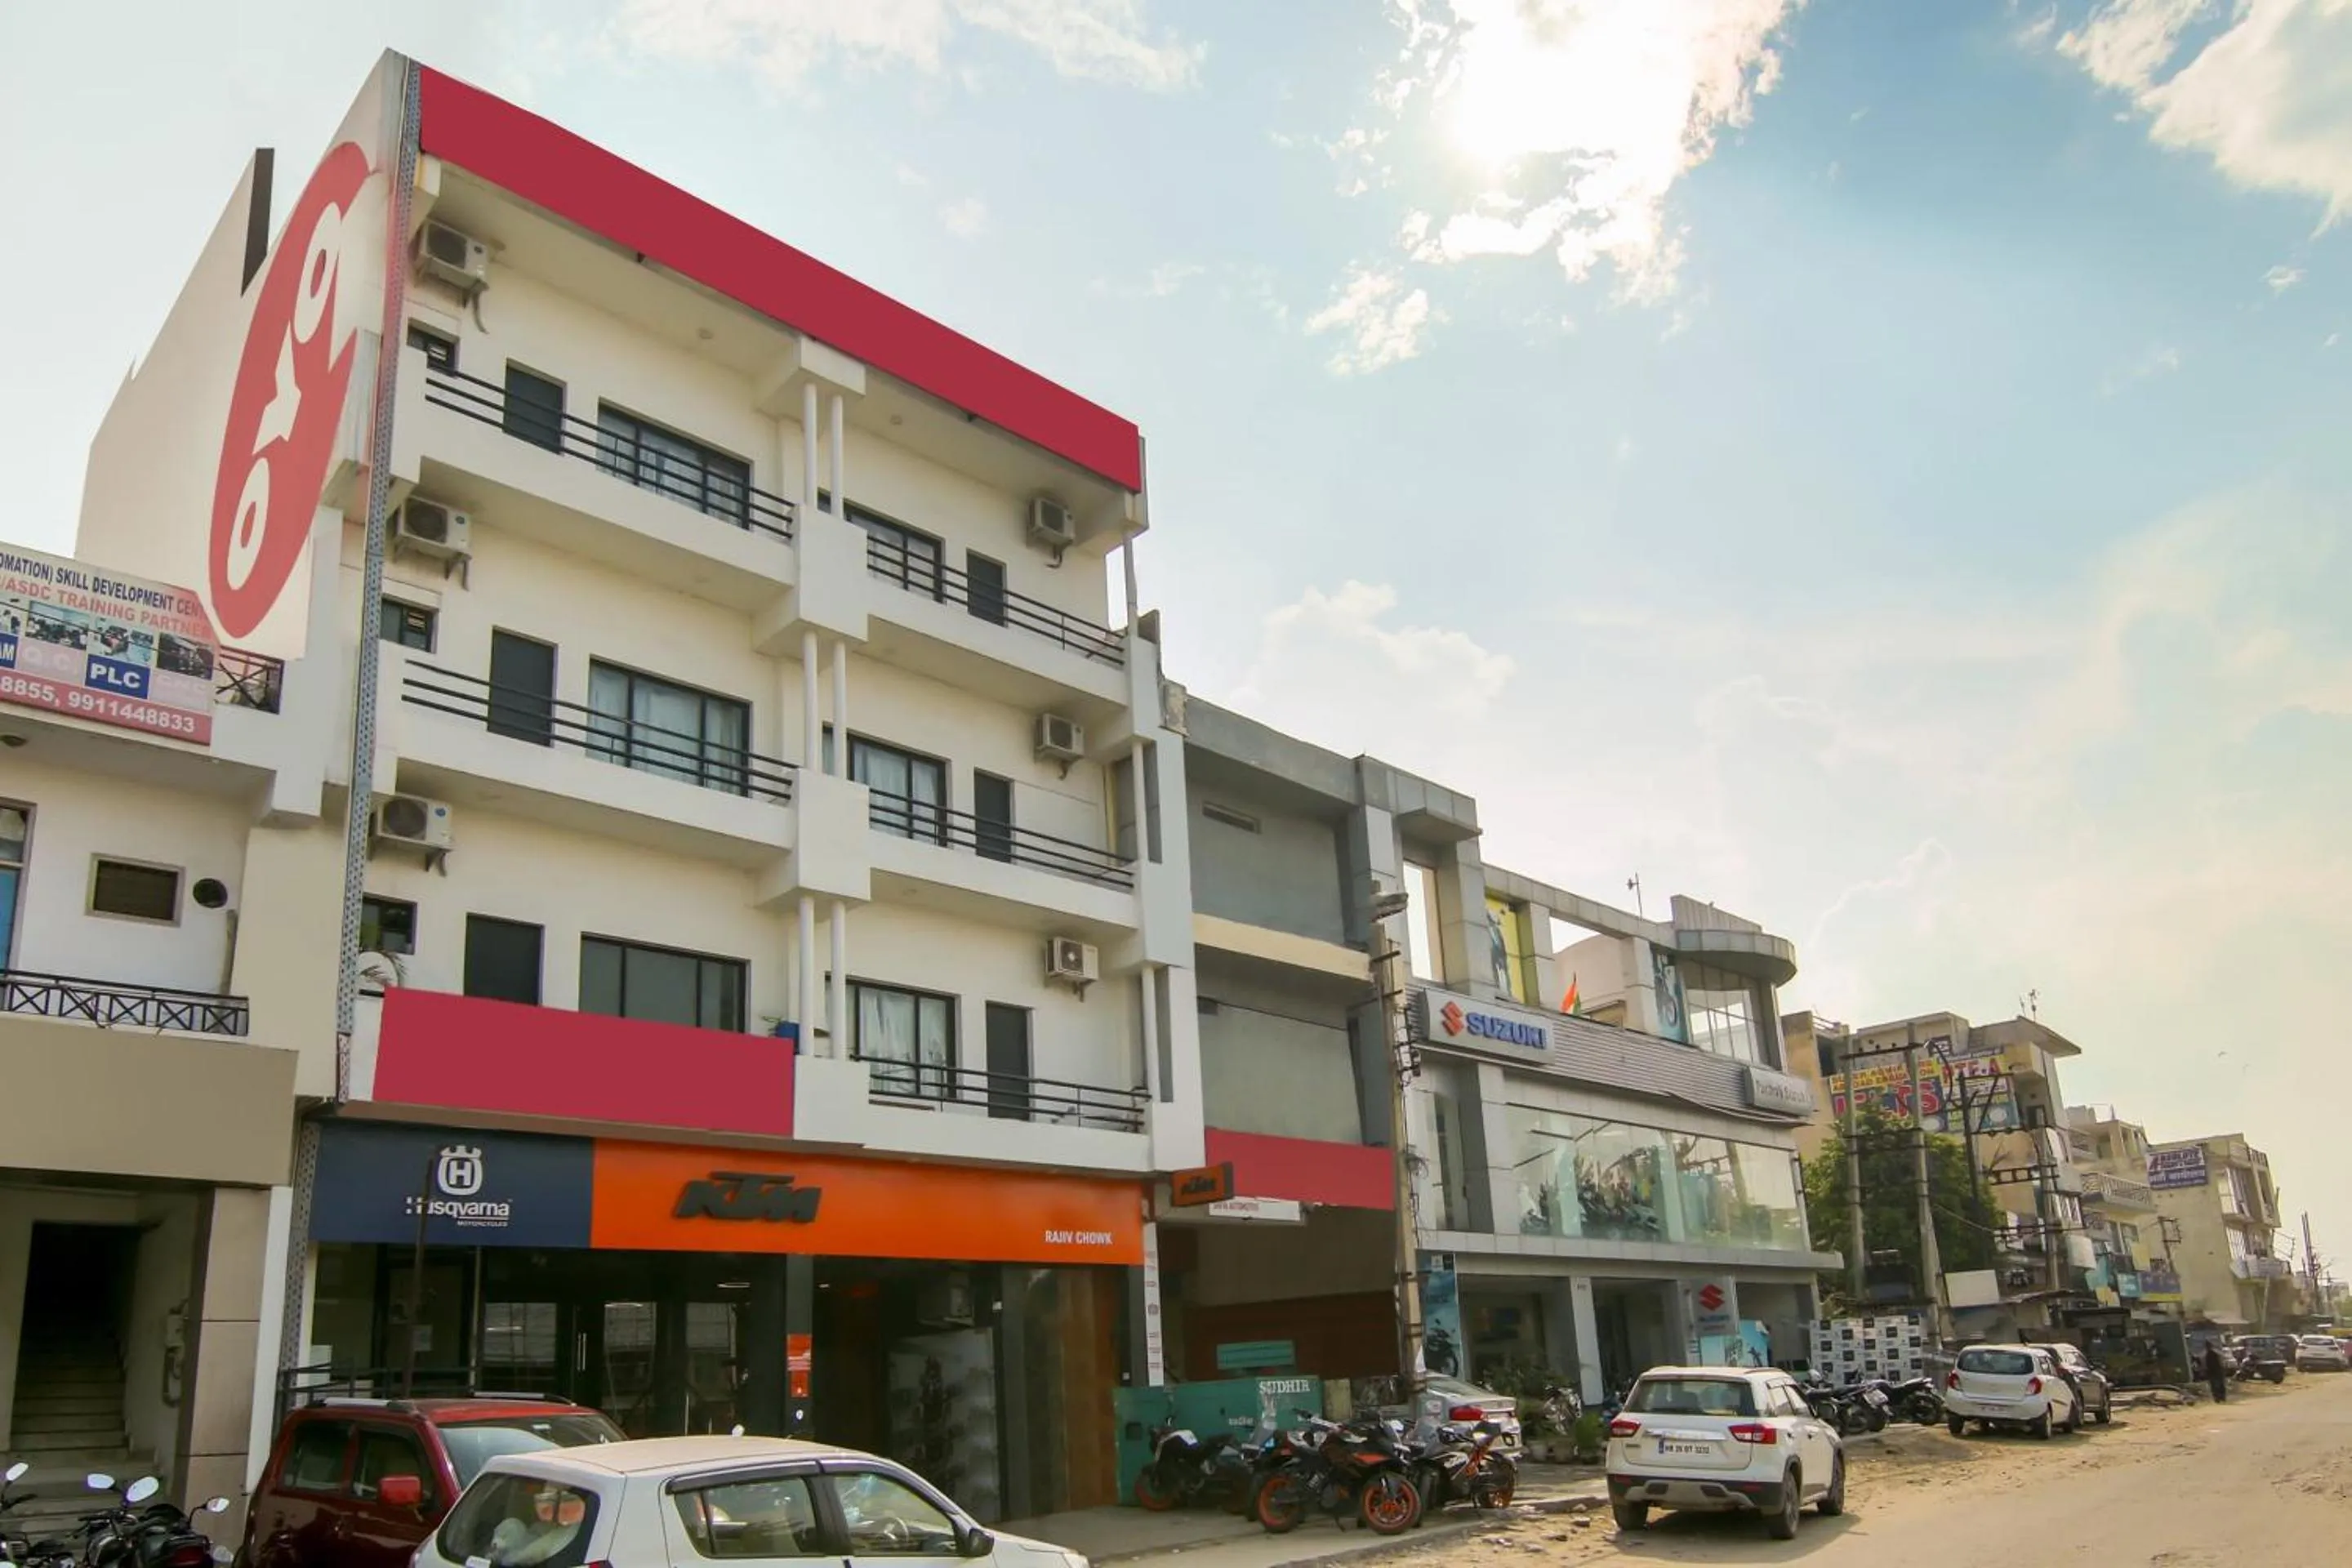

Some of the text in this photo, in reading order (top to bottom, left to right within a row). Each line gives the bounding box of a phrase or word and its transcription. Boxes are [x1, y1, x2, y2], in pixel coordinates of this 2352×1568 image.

[226, 201, 341, 591] OYO
[56, 567, 88, 590] SKILL
[92, 576, 173, 611] DEVELOPMENT
[57, 590, 136, 622] TRAINING
[0, 642, 15, 661] M
[91, 662, 141, 688] PLC
[68, 691, 195, 733] 9911448833
[1466, 1012, 1547, 1049] SUZUKI
[673, 1171, 822, 1223] KTM
[1045, 1230, 1113, 1245] RAJIV CHOWK
